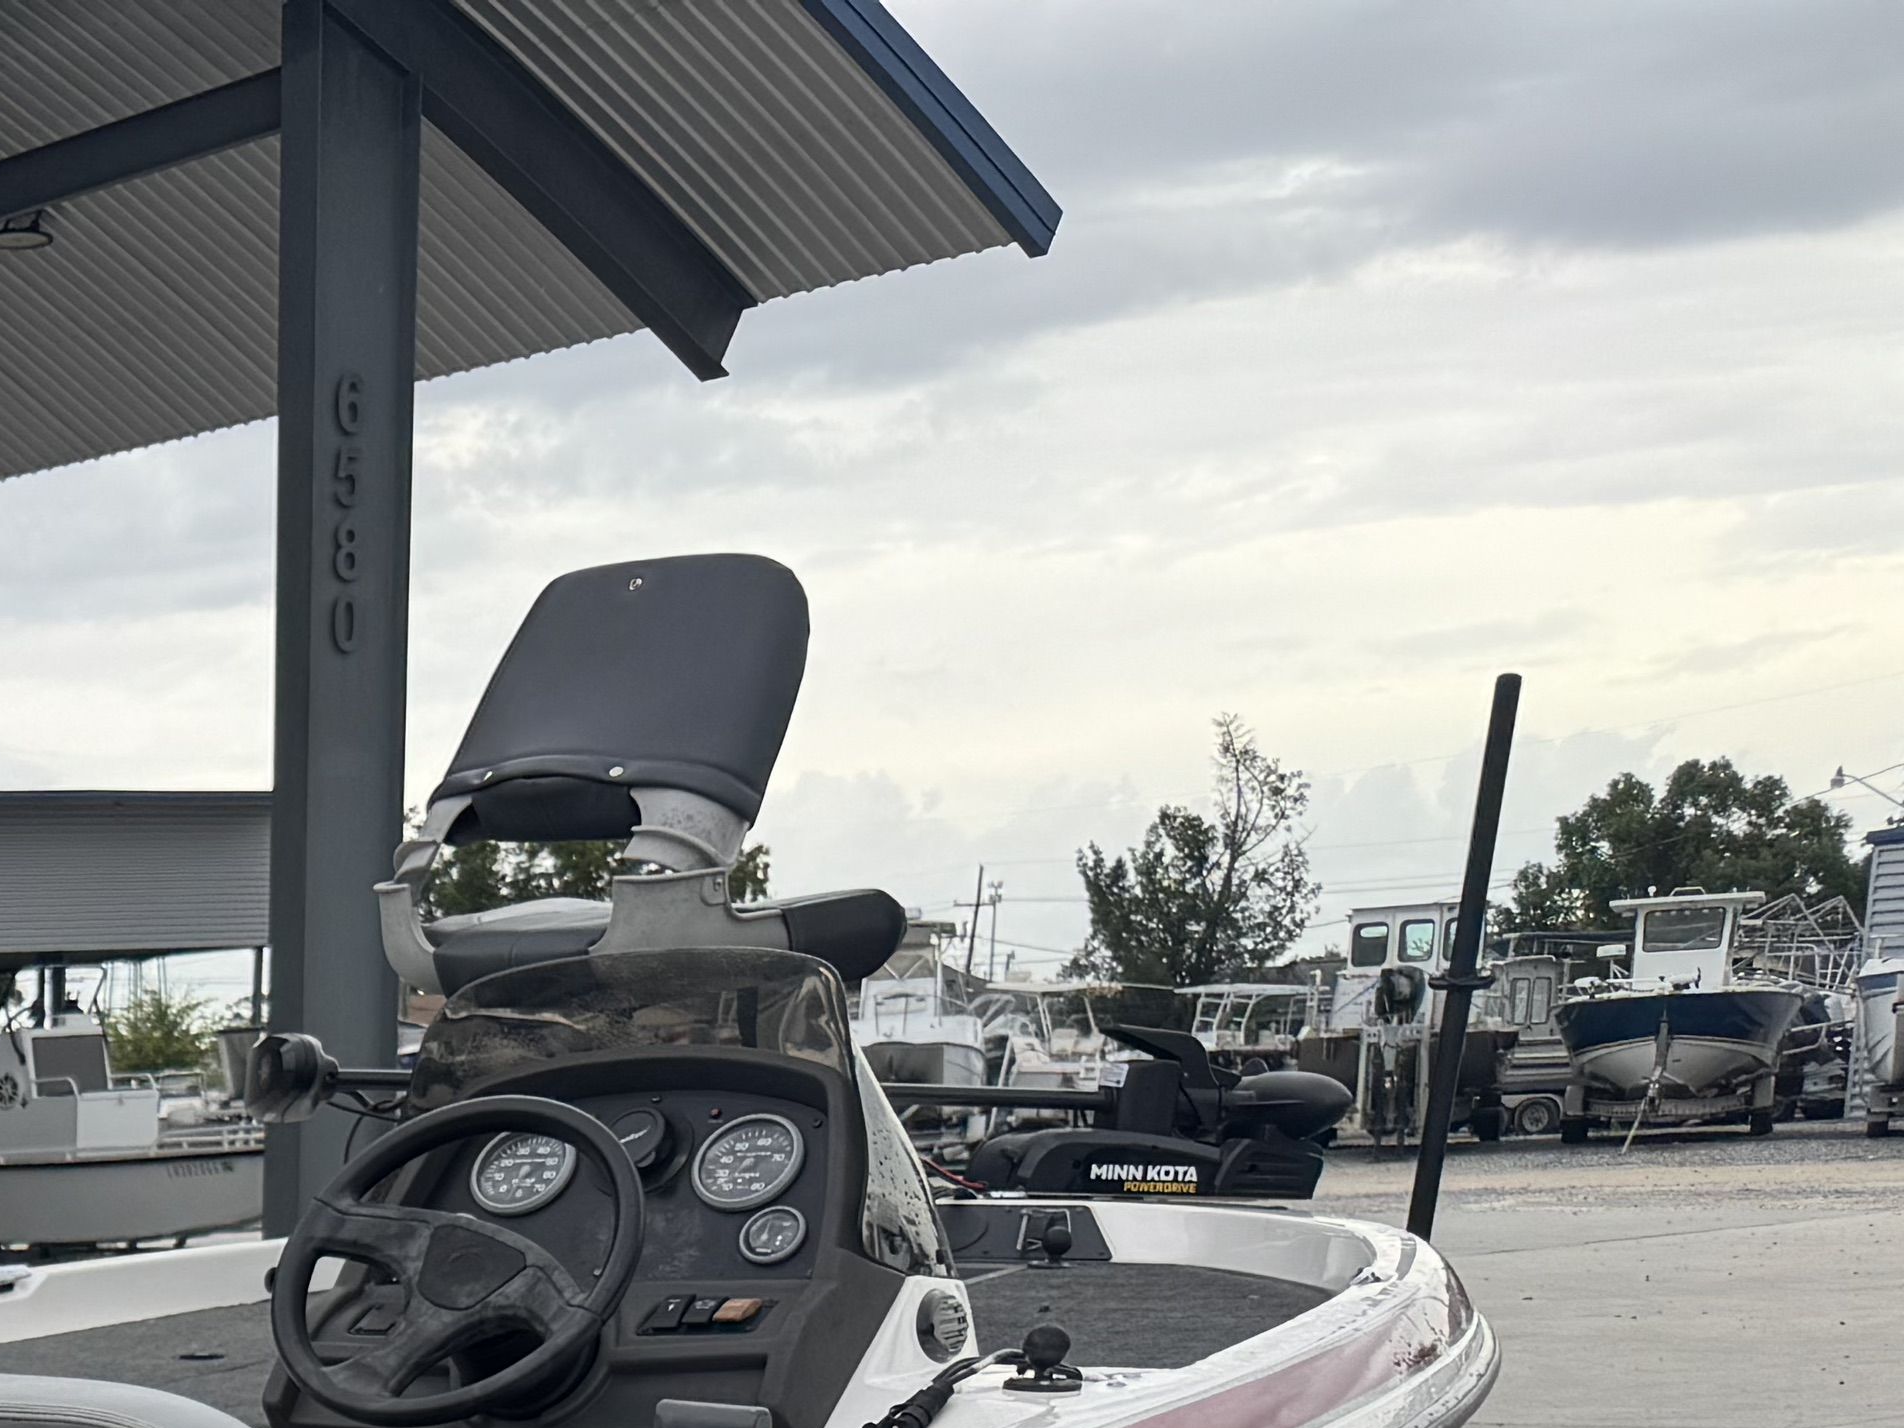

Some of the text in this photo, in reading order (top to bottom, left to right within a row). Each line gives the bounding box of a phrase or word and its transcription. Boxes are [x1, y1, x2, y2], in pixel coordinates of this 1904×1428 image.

[330, 372, 364, 655] 6580
[1090, 1164, 1198, 1182] MINN KOTA
[1123, 1181, 1197, 1193] POWERDRIVE
